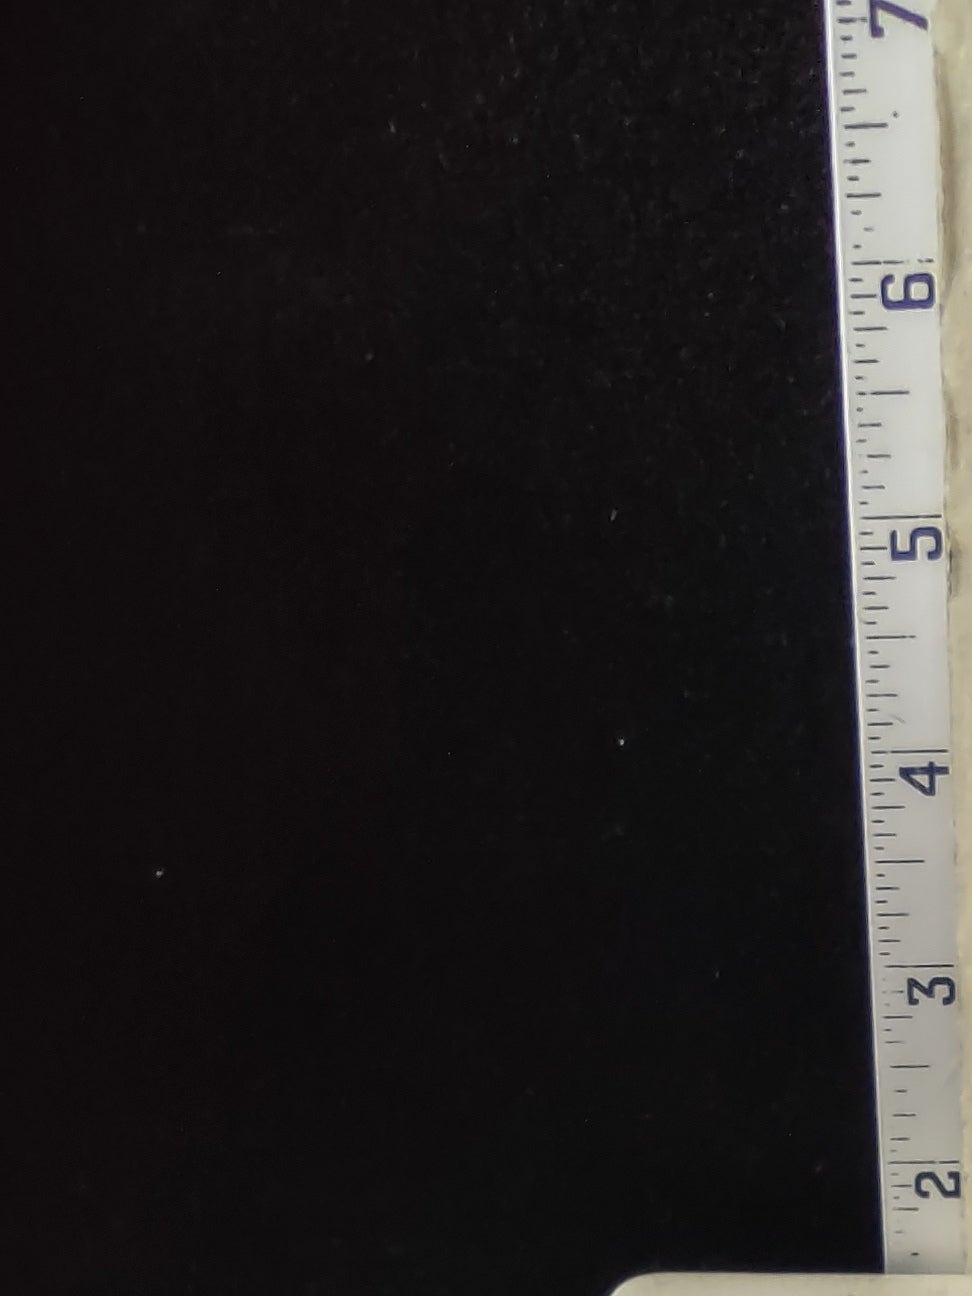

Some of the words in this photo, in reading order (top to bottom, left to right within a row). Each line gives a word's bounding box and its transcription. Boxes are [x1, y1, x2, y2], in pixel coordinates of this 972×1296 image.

[869, 0, 928, 38] 7
[880, 273, 935, 310] 6
[890, 526, 943, 561] 5
[899, 761, 949, 796] 4
[907, 976, 956, 1006] 3
[914, 1171, 961, 1198] 2
